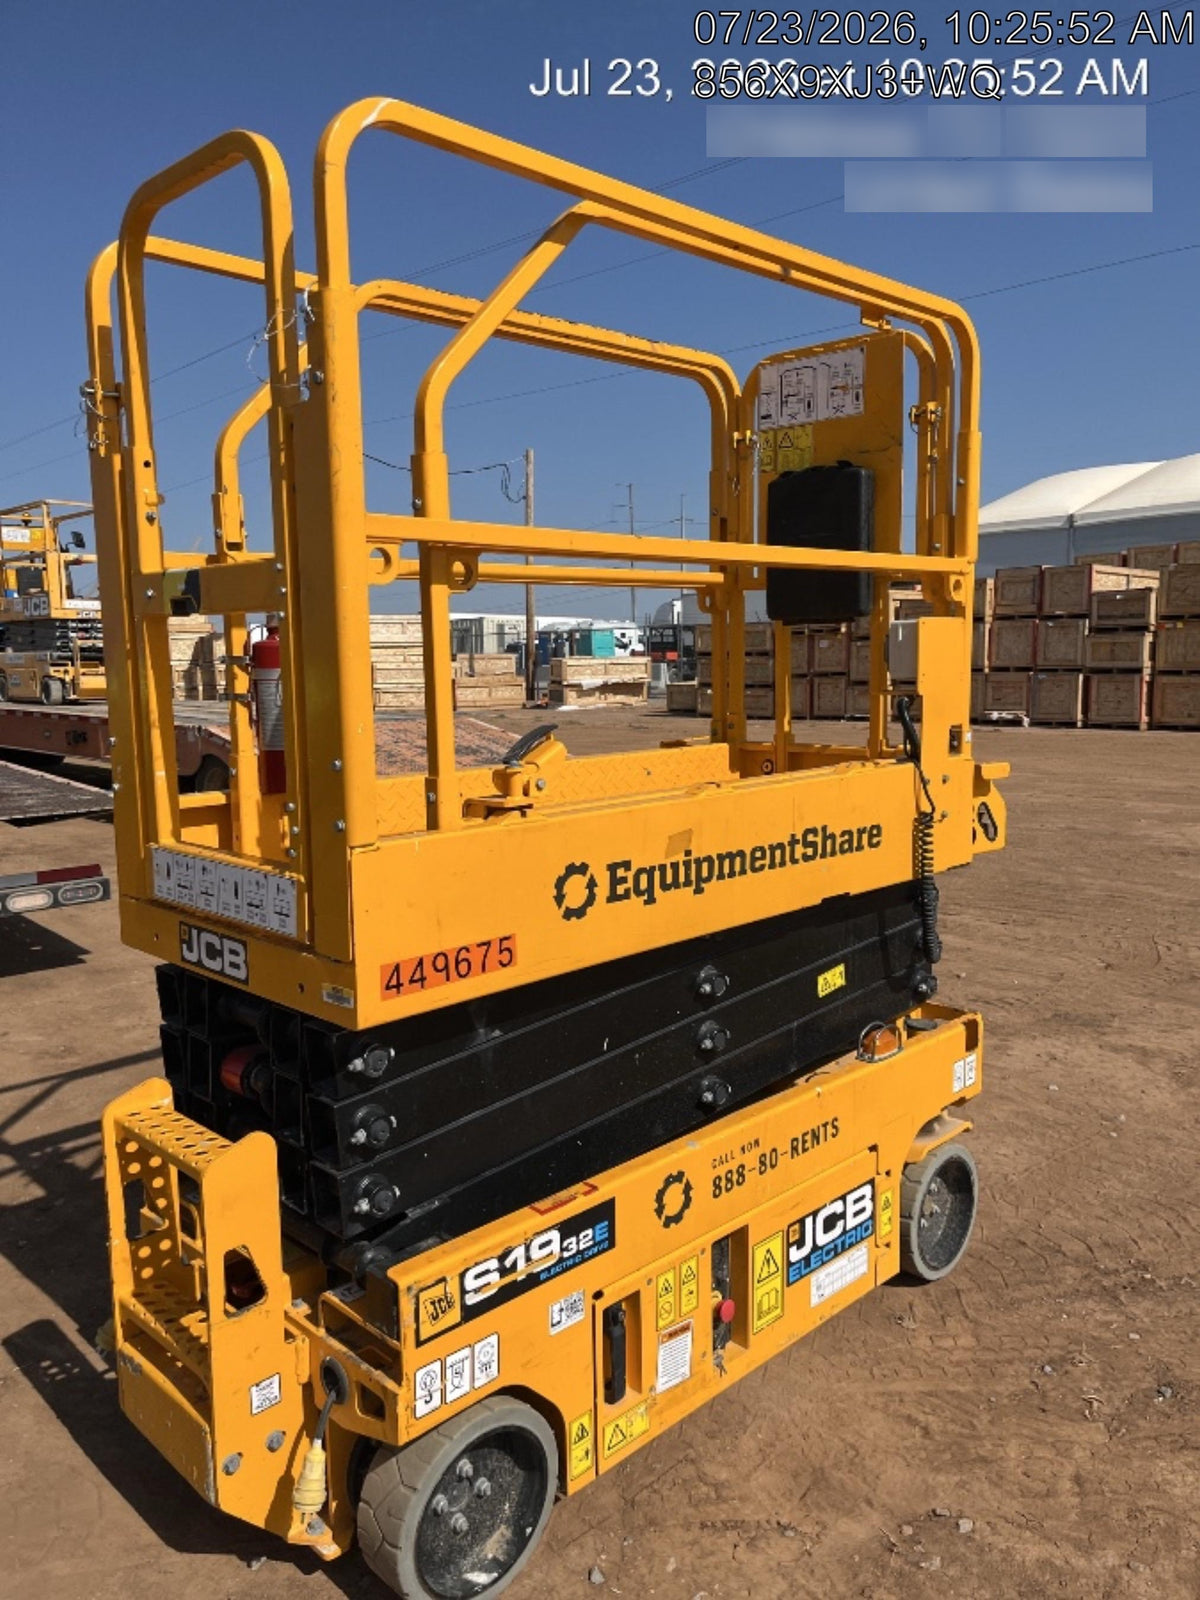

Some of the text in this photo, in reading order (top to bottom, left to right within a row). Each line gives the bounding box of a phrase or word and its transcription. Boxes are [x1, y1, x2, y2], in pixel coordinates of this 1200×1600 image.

[24, 597, 49, 617] JCB
[605, 823, 882, 907] EquipmentShare
[182, 927, 248, 980] JCB
[384, 935, 514, 996] 449675
[711, 1150, 735, 1170] CALL
[712, 1117, 840, 1199] 888-80-RENTS
[788, 1184, 874, 1263] JCB
[788, 1219, 873, 1285] ELECTRIC
